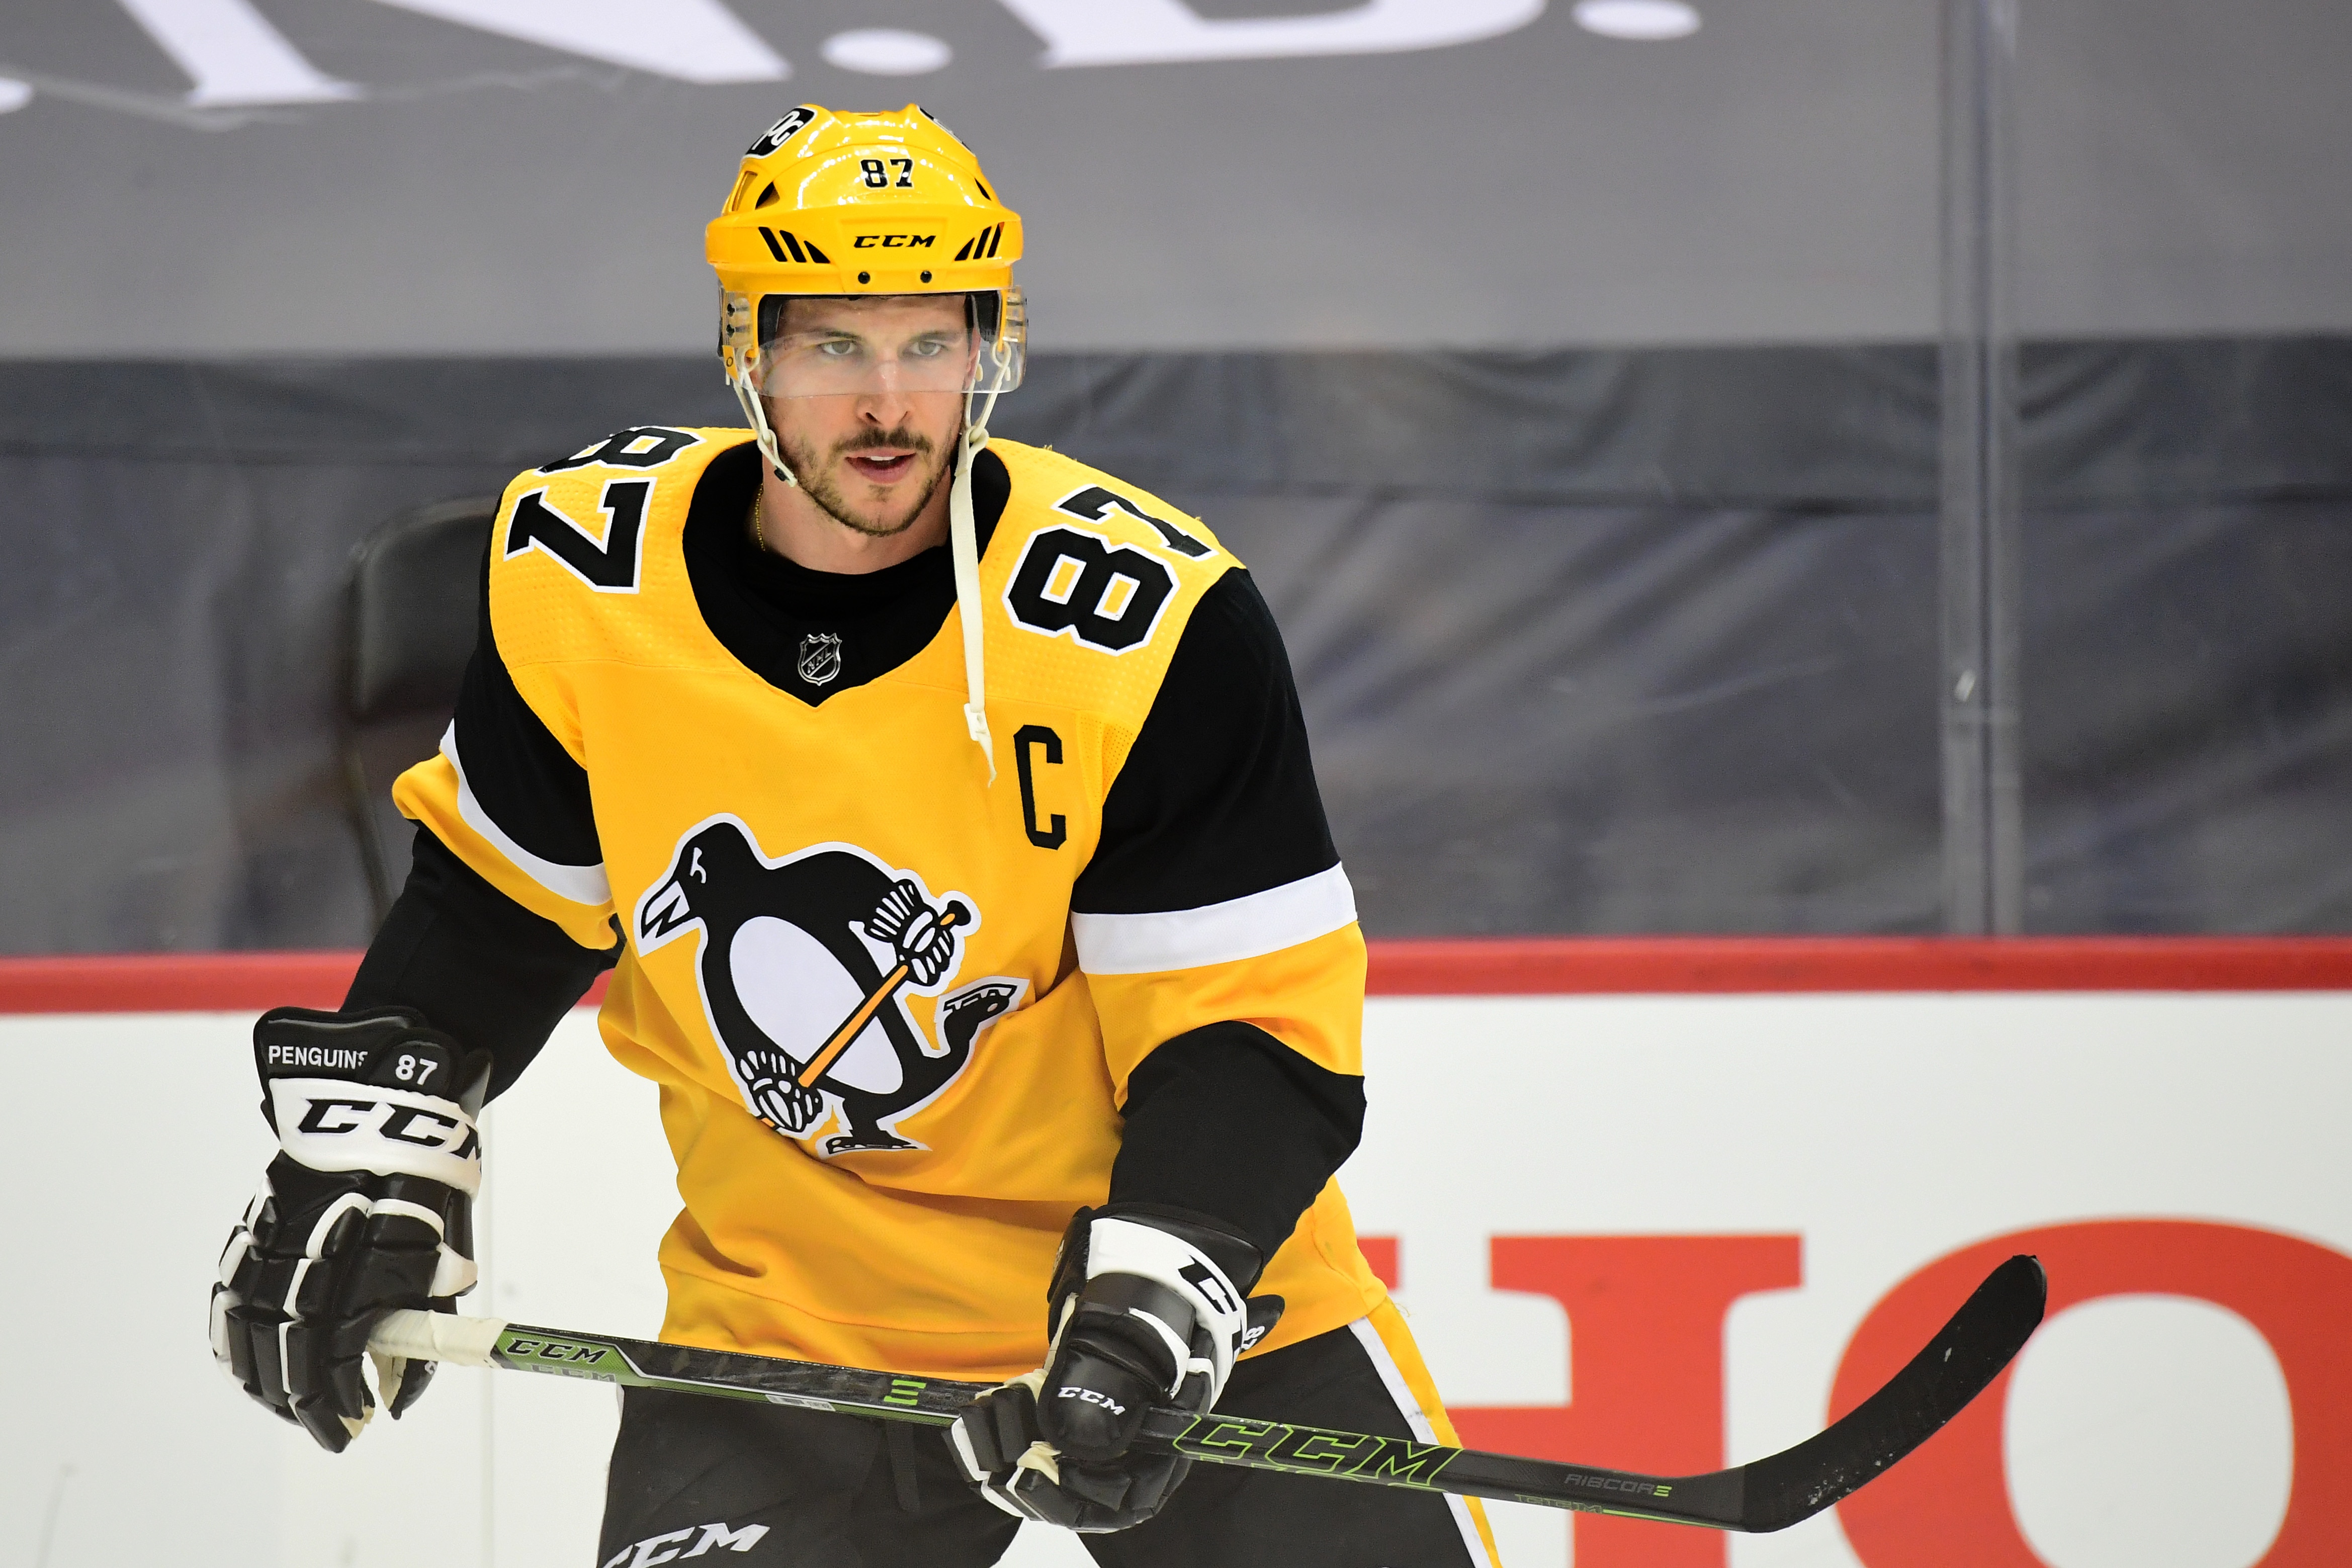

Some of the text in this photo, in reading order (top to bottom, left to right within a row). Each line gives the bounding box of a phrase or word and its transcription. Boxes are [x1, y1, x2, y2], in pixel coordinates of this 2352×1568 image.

[859, 158, 914, 189] 87
[853, 234, 937, 248] CCM
[503, 425, 706, 594] 87
[1002, 484, 1219, 656] 87
[807, 648, 832, 674] NHL
[1013, 724, 1067, 850] C
[395, 1055, 438, 1085] 87
[506, 1338, 609, 1365] CCM
[1058, 1386, 1125, 1415] CCM
[1173, 1413, 1463, 1487] CCM
